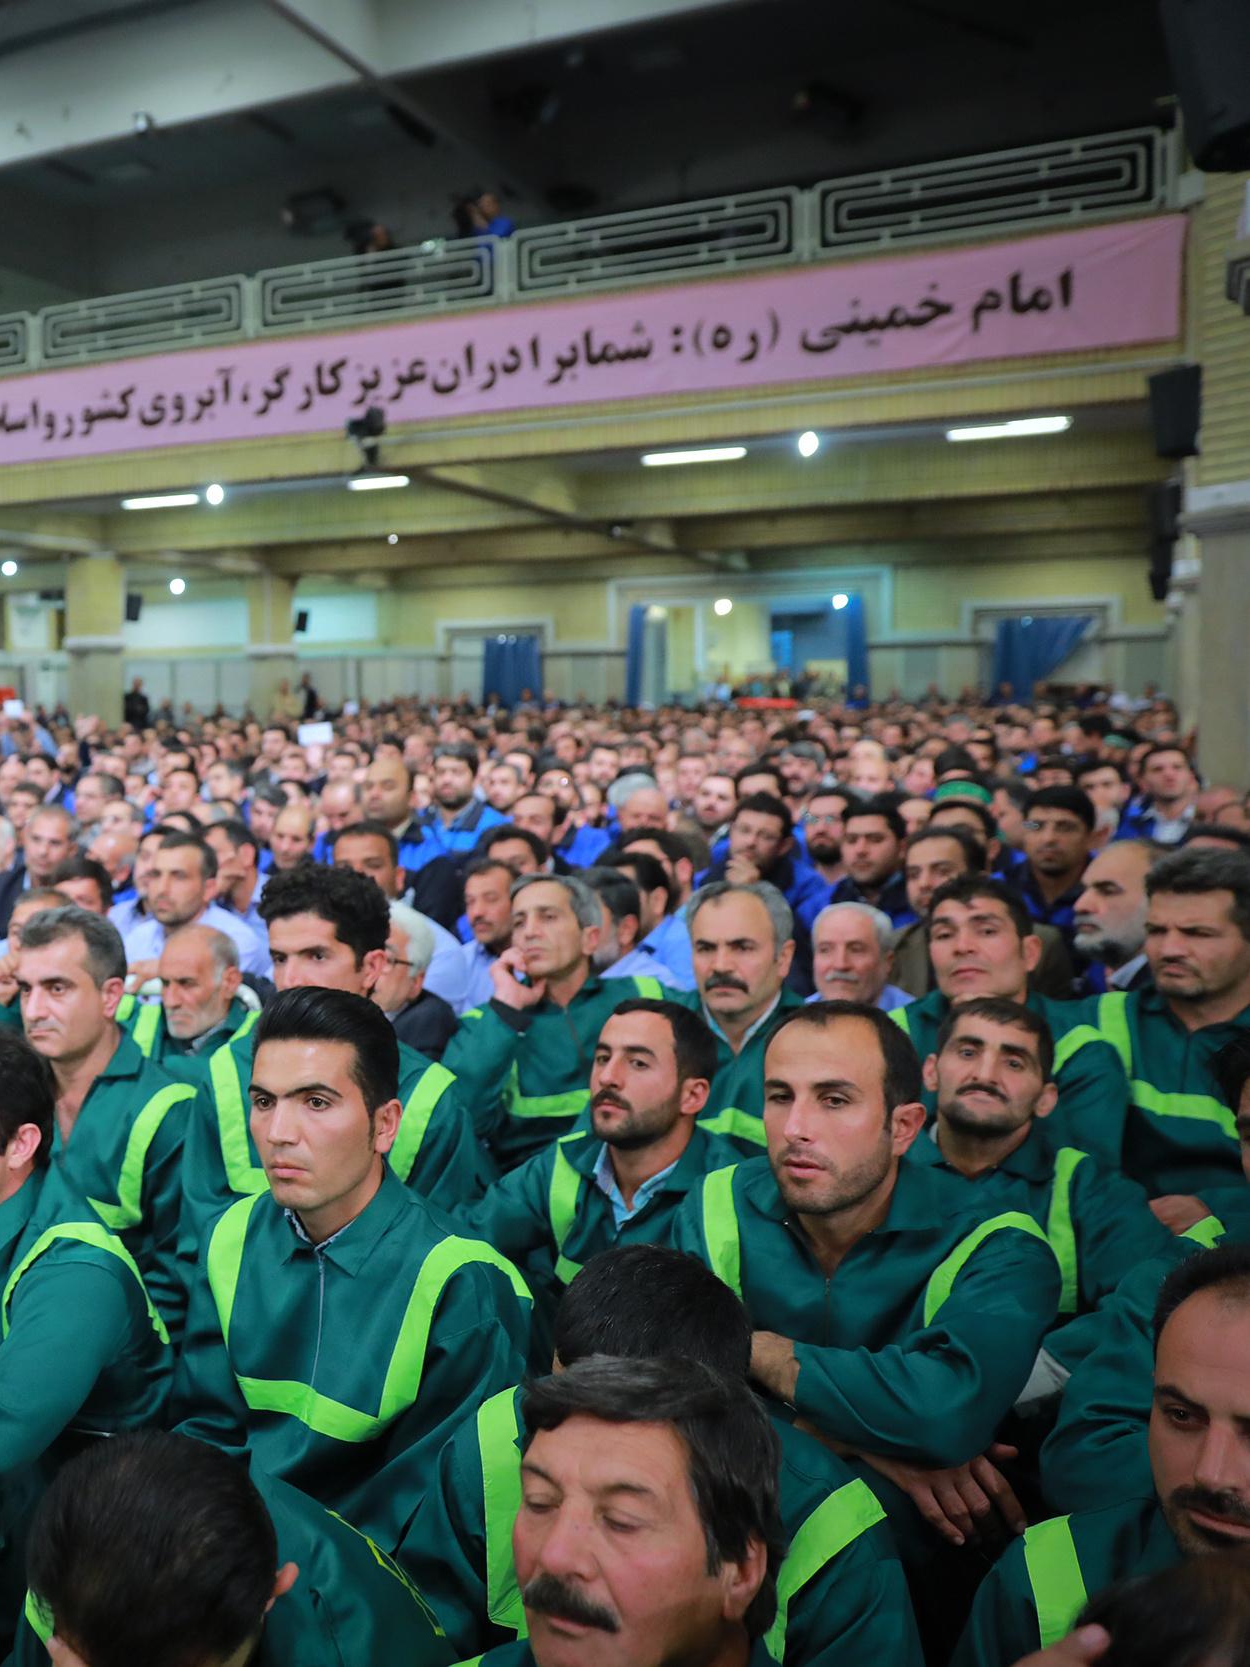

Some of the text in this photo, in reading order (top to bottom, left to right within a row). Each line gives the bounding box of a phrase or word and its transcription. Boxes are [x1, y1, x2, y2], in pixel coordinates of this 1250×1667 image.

[801, 282, 953, 353] خمینی
[971, 268, 1073, 333] امام
[138, 365, 236, 426] آبروی
[352, 356, 427, 405] عزیز
[61, 384, 137, 439] کشور
